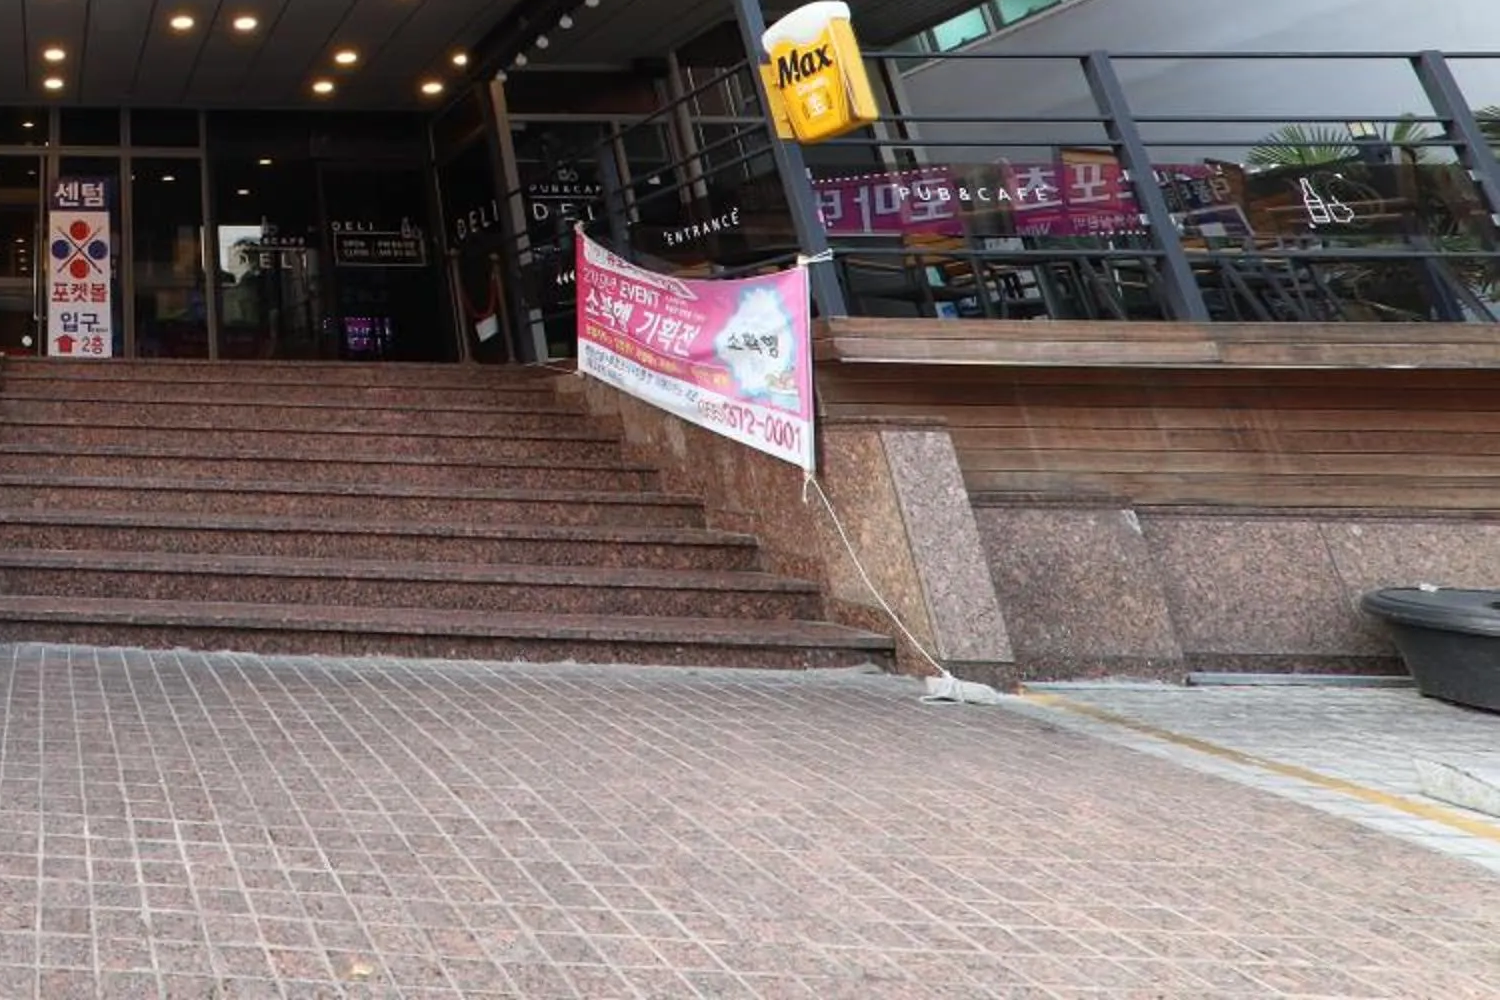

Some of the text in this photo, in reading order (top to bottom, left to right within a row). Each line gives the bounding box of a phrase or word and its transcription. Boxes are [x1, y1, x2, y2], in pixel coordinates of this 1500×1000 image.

[777, 43, 833, 90] Max
[55, 181, 105, 207] 센텀
[898, 186, 1049, 202] PUB&CAFE
[457, 200, 499, 240] DELI
[51, 283, 108, 303] 포켓볼
[620, 281, 661, 309] EVENT
[60, 312, 101, 333] 입구
[636, 310, 700, 356] 기획전
[81, 336, 105, 354] 2층
